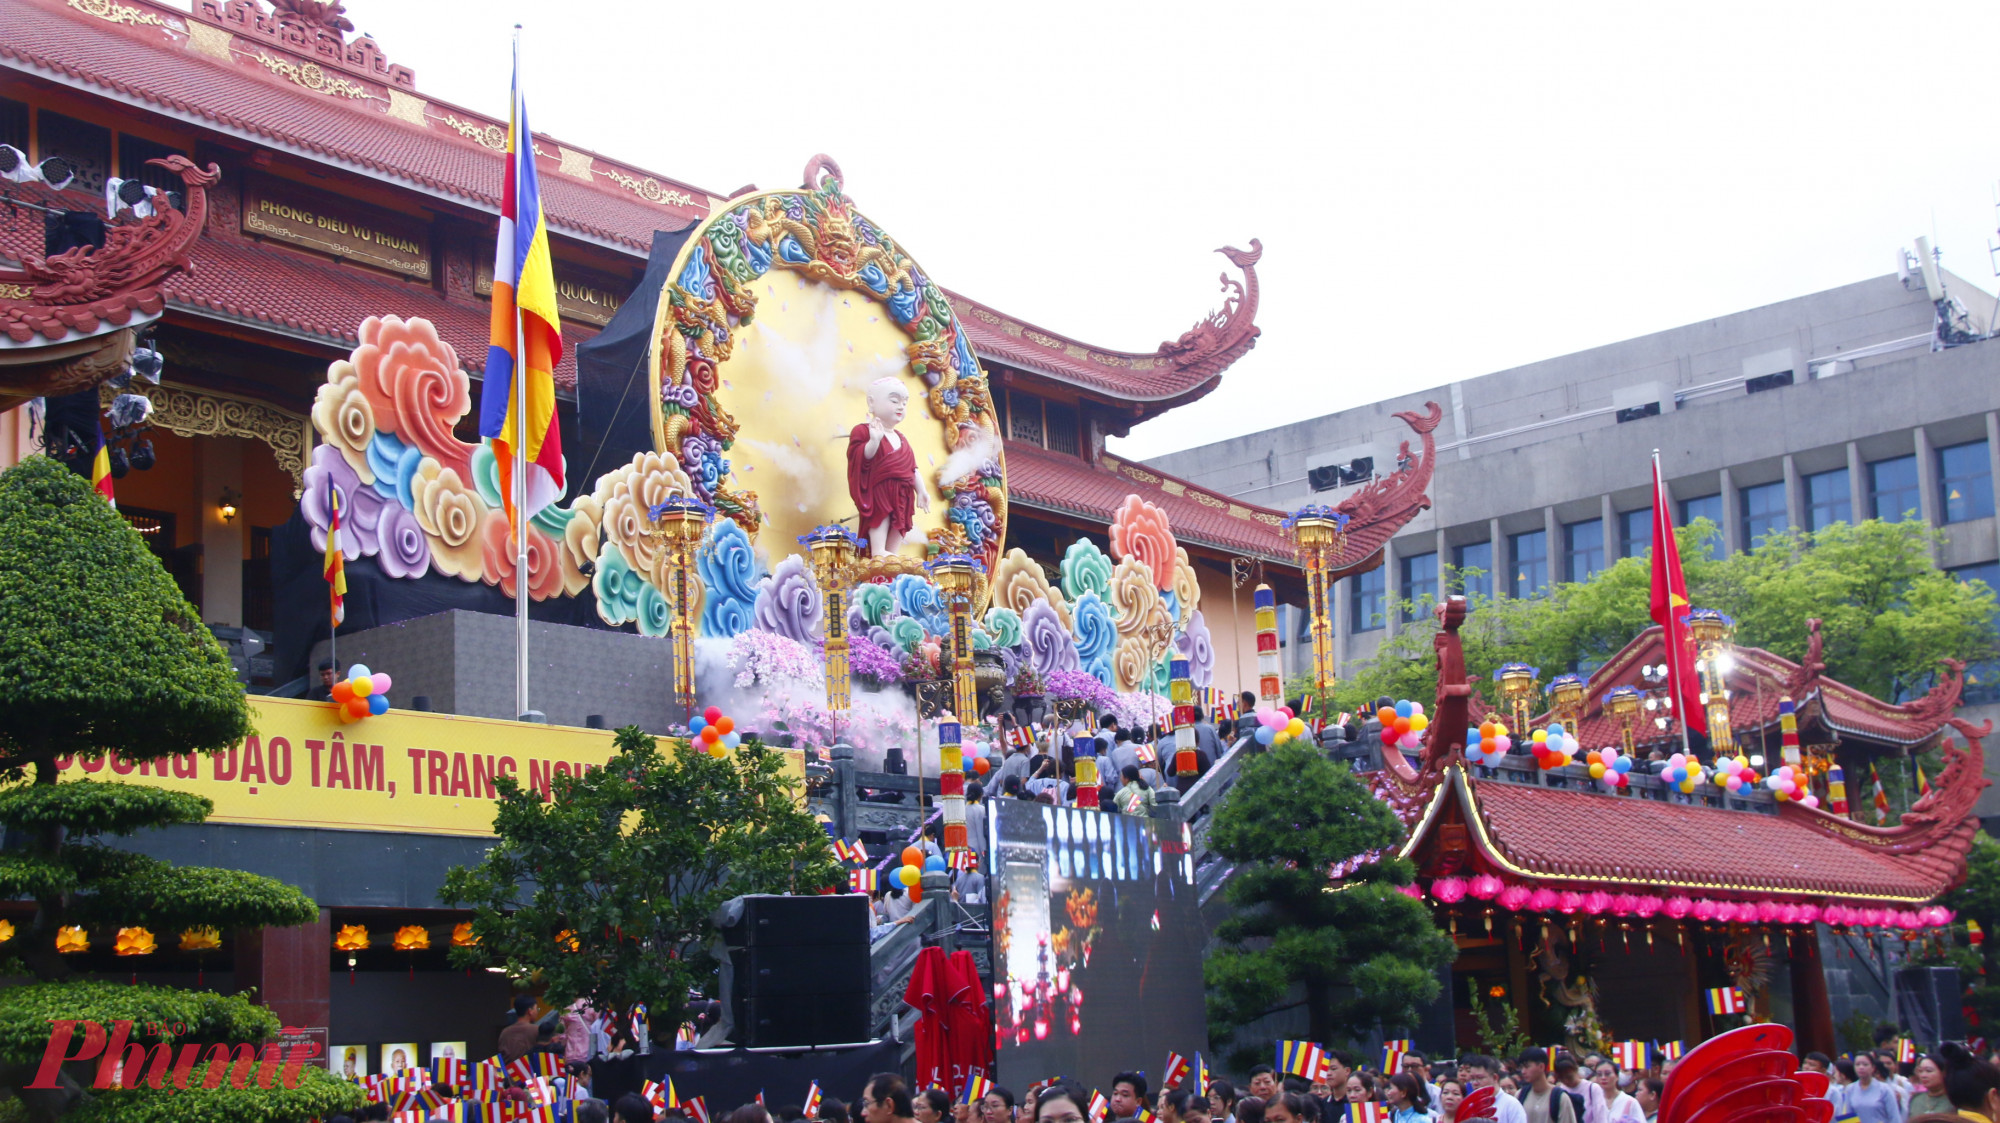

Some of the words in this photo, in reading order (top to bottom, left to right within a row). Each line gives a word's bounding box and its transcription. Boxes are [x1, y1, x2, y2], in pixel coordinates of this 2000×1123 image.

[260, 199, 314, 225] PHONG
[212, 734, 292, 795] ĐẠO
[305, 728, 396, 798] TÂM,
